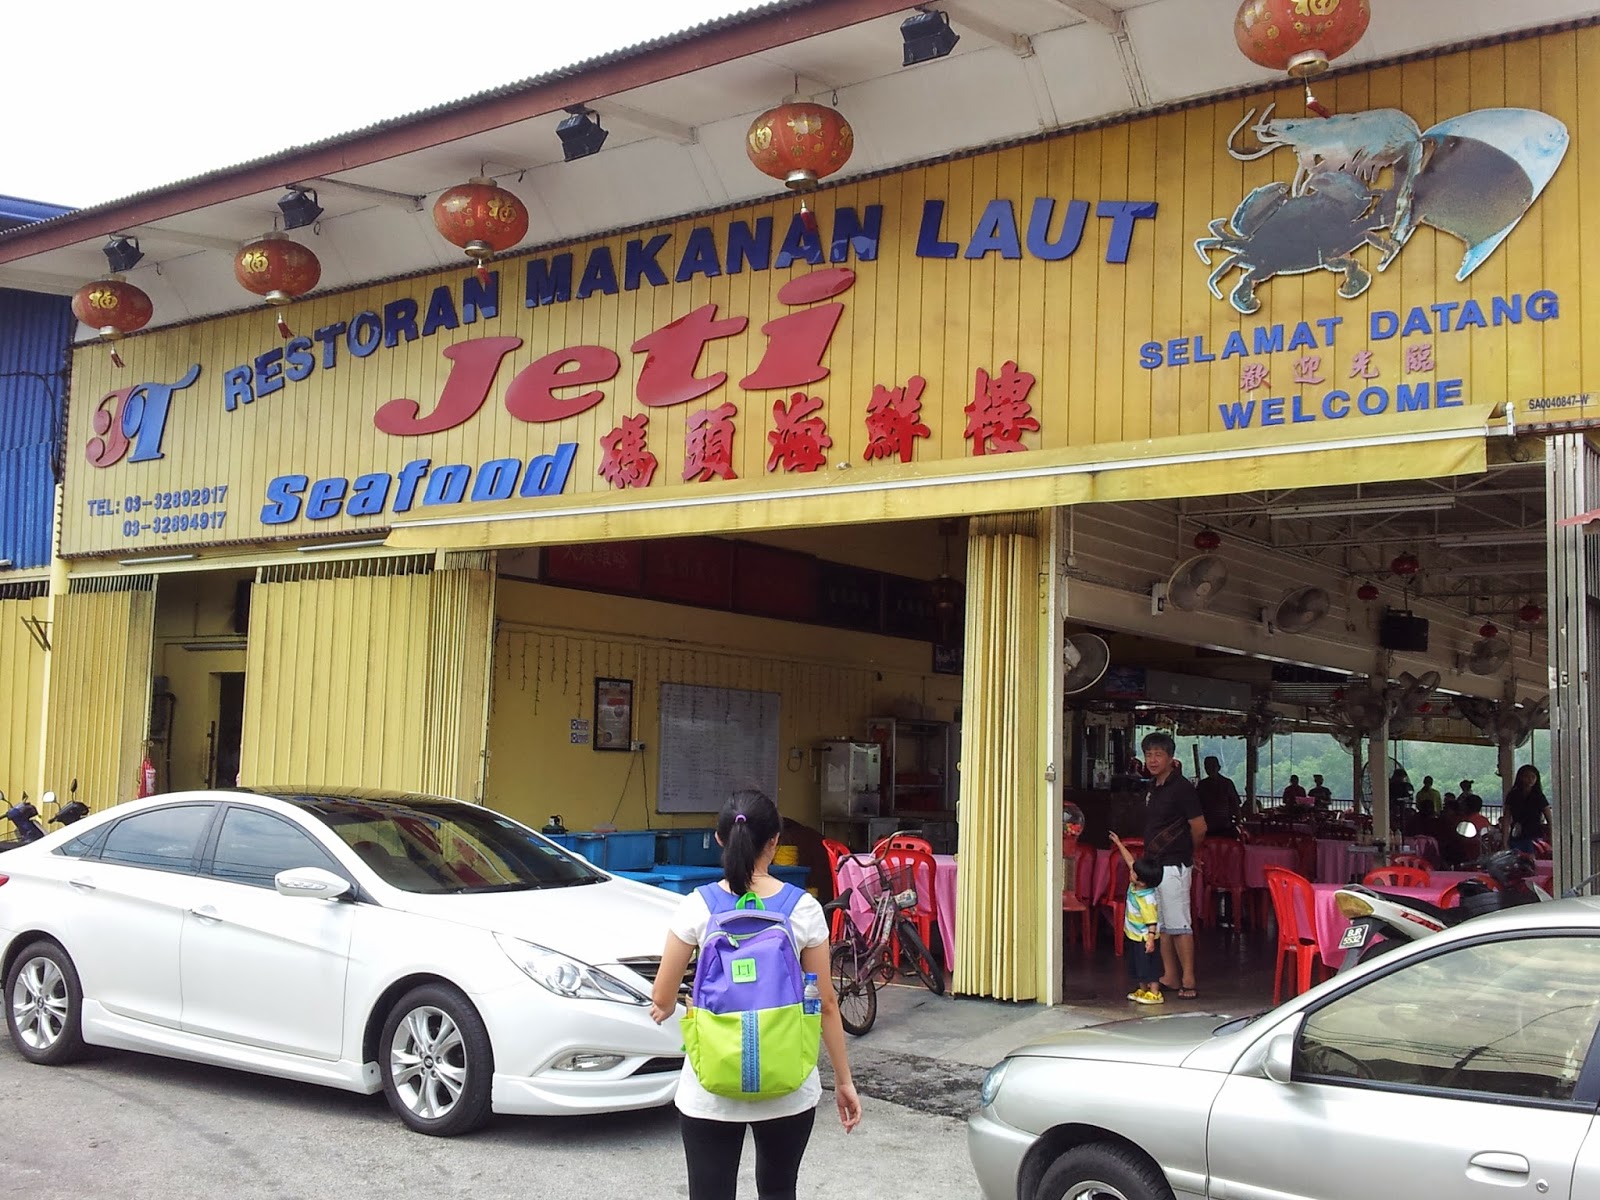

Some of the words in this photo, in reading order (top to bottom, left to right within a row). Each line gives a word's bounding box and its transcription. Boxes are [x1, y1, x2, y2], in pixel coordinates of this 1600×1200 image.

[223, 270, 498, 412] RESTORAN
[525, 203, 883, 309] MAKANAN
[916, 197, 1158, 264] LAUT
[1139, 316, 1343, 369] SELAMAT
[1370, 289, 1560, 341] DATANG
[374, 267, 856, 437] Jeti
[599, 361, 1040, 489] 碼頭海鮮樓
[1219, 378, 1464, 431] WELCOME
[1528, 394, 1590, 410] SA0040847-W
[87, 498, 121, 517] TEL:
[124, 484, 228, 513] 03-32892917
[259, 441, 579, 526] Seafood
[122, 511, 227, 537] 03-32894917
